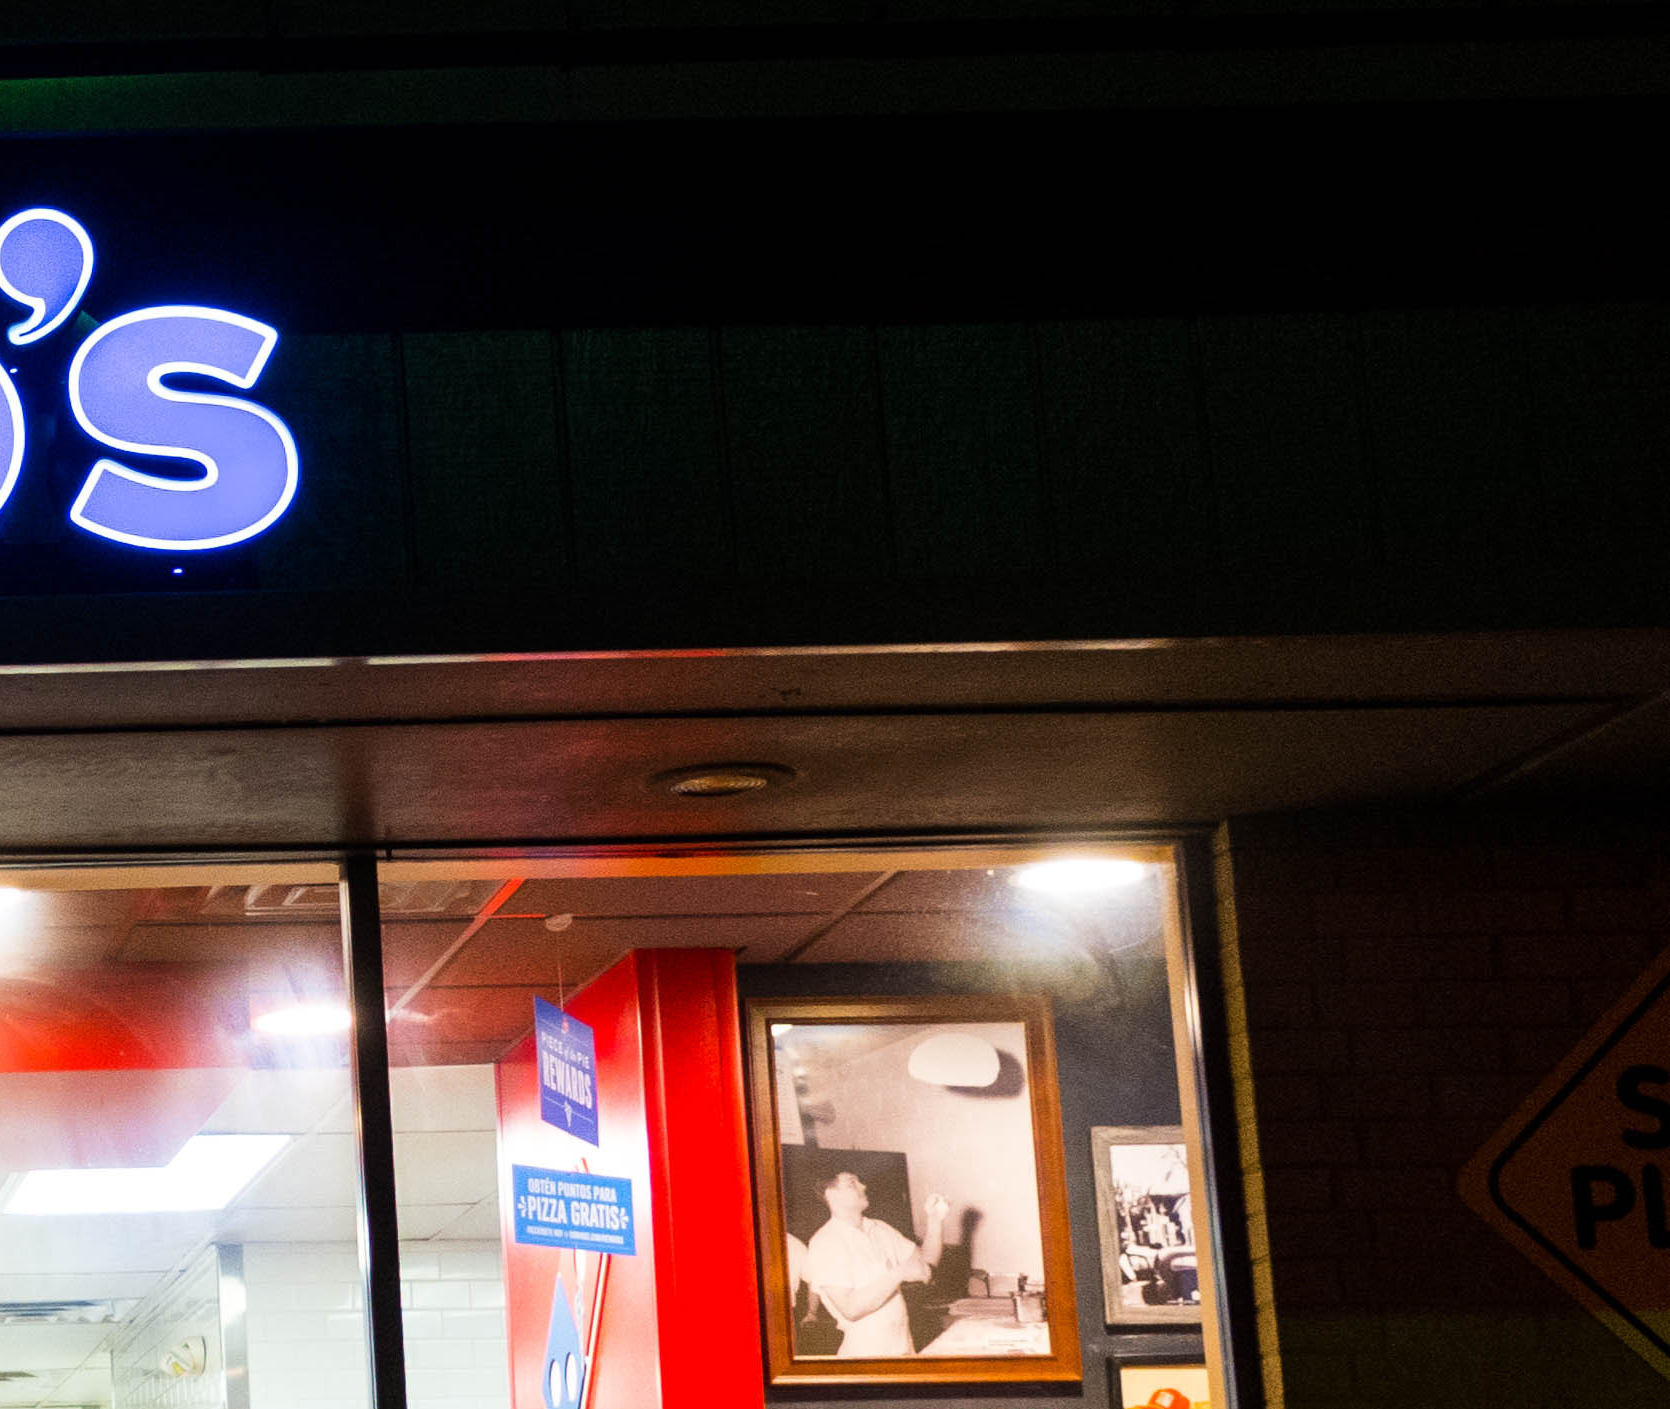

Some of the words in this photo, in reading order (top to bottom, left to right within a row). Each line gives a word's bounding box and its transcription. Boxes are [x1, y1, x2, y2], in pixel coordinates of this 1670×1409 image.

[541, 1050, 593, 1110] REWARDS
[556, 1180, 592, 1199] PUNTOS
[592, 1183, 618, 1204] PARA
[527, 1198, 568, 1226] PIZZA
[570, 1203, 620, 1232] GRATIS
